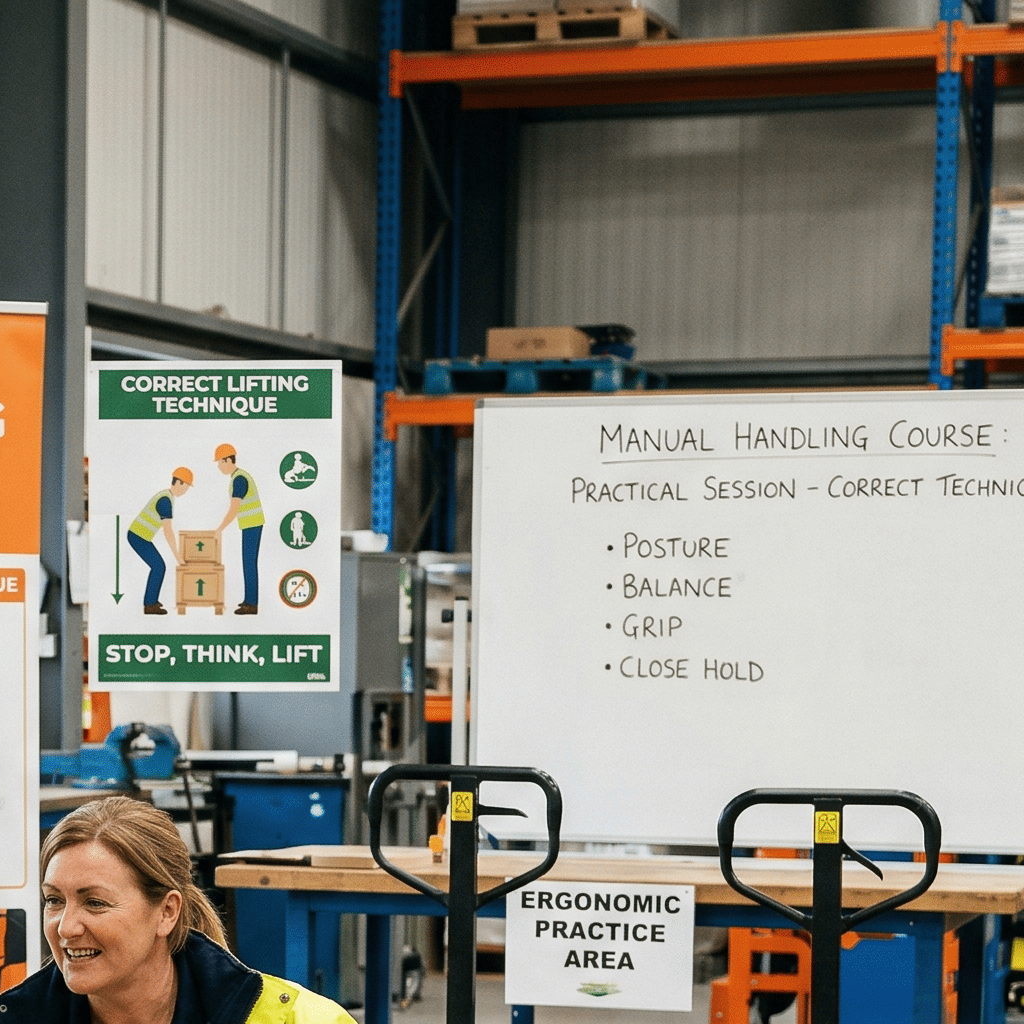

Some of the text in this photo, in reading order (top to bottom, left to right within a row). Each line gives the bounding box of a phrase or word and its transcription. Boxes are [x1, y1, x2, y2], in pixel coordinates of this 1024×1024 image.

[120, 375, 309, 392] CORRECT LIFTING
[151, 396, 277, 416] TECHNIQUE
[600, 423, 714, 454] MANUAL
[735, 422, 869, 451] HANDLING
[572, 476, 688, 503] PRACTICAL
[703, 475, 796, 500] SESSION
[827, 474, 924, 499] CORRECT
[623, 532, 731, 559] POSTURE
[623, 573, 732, 599] BALANCE
[622, 614, 683, 640] GRIP
[105, 644, 323, 667] STOP, THINK, LIFT
[619, 655, 764, 683] CLOSE HOLD
[521, 891, 681, 914] ERGONOMIC
[535, 920, 665, 943] PRACTICE
[564, 950, 635, 970] AREA
